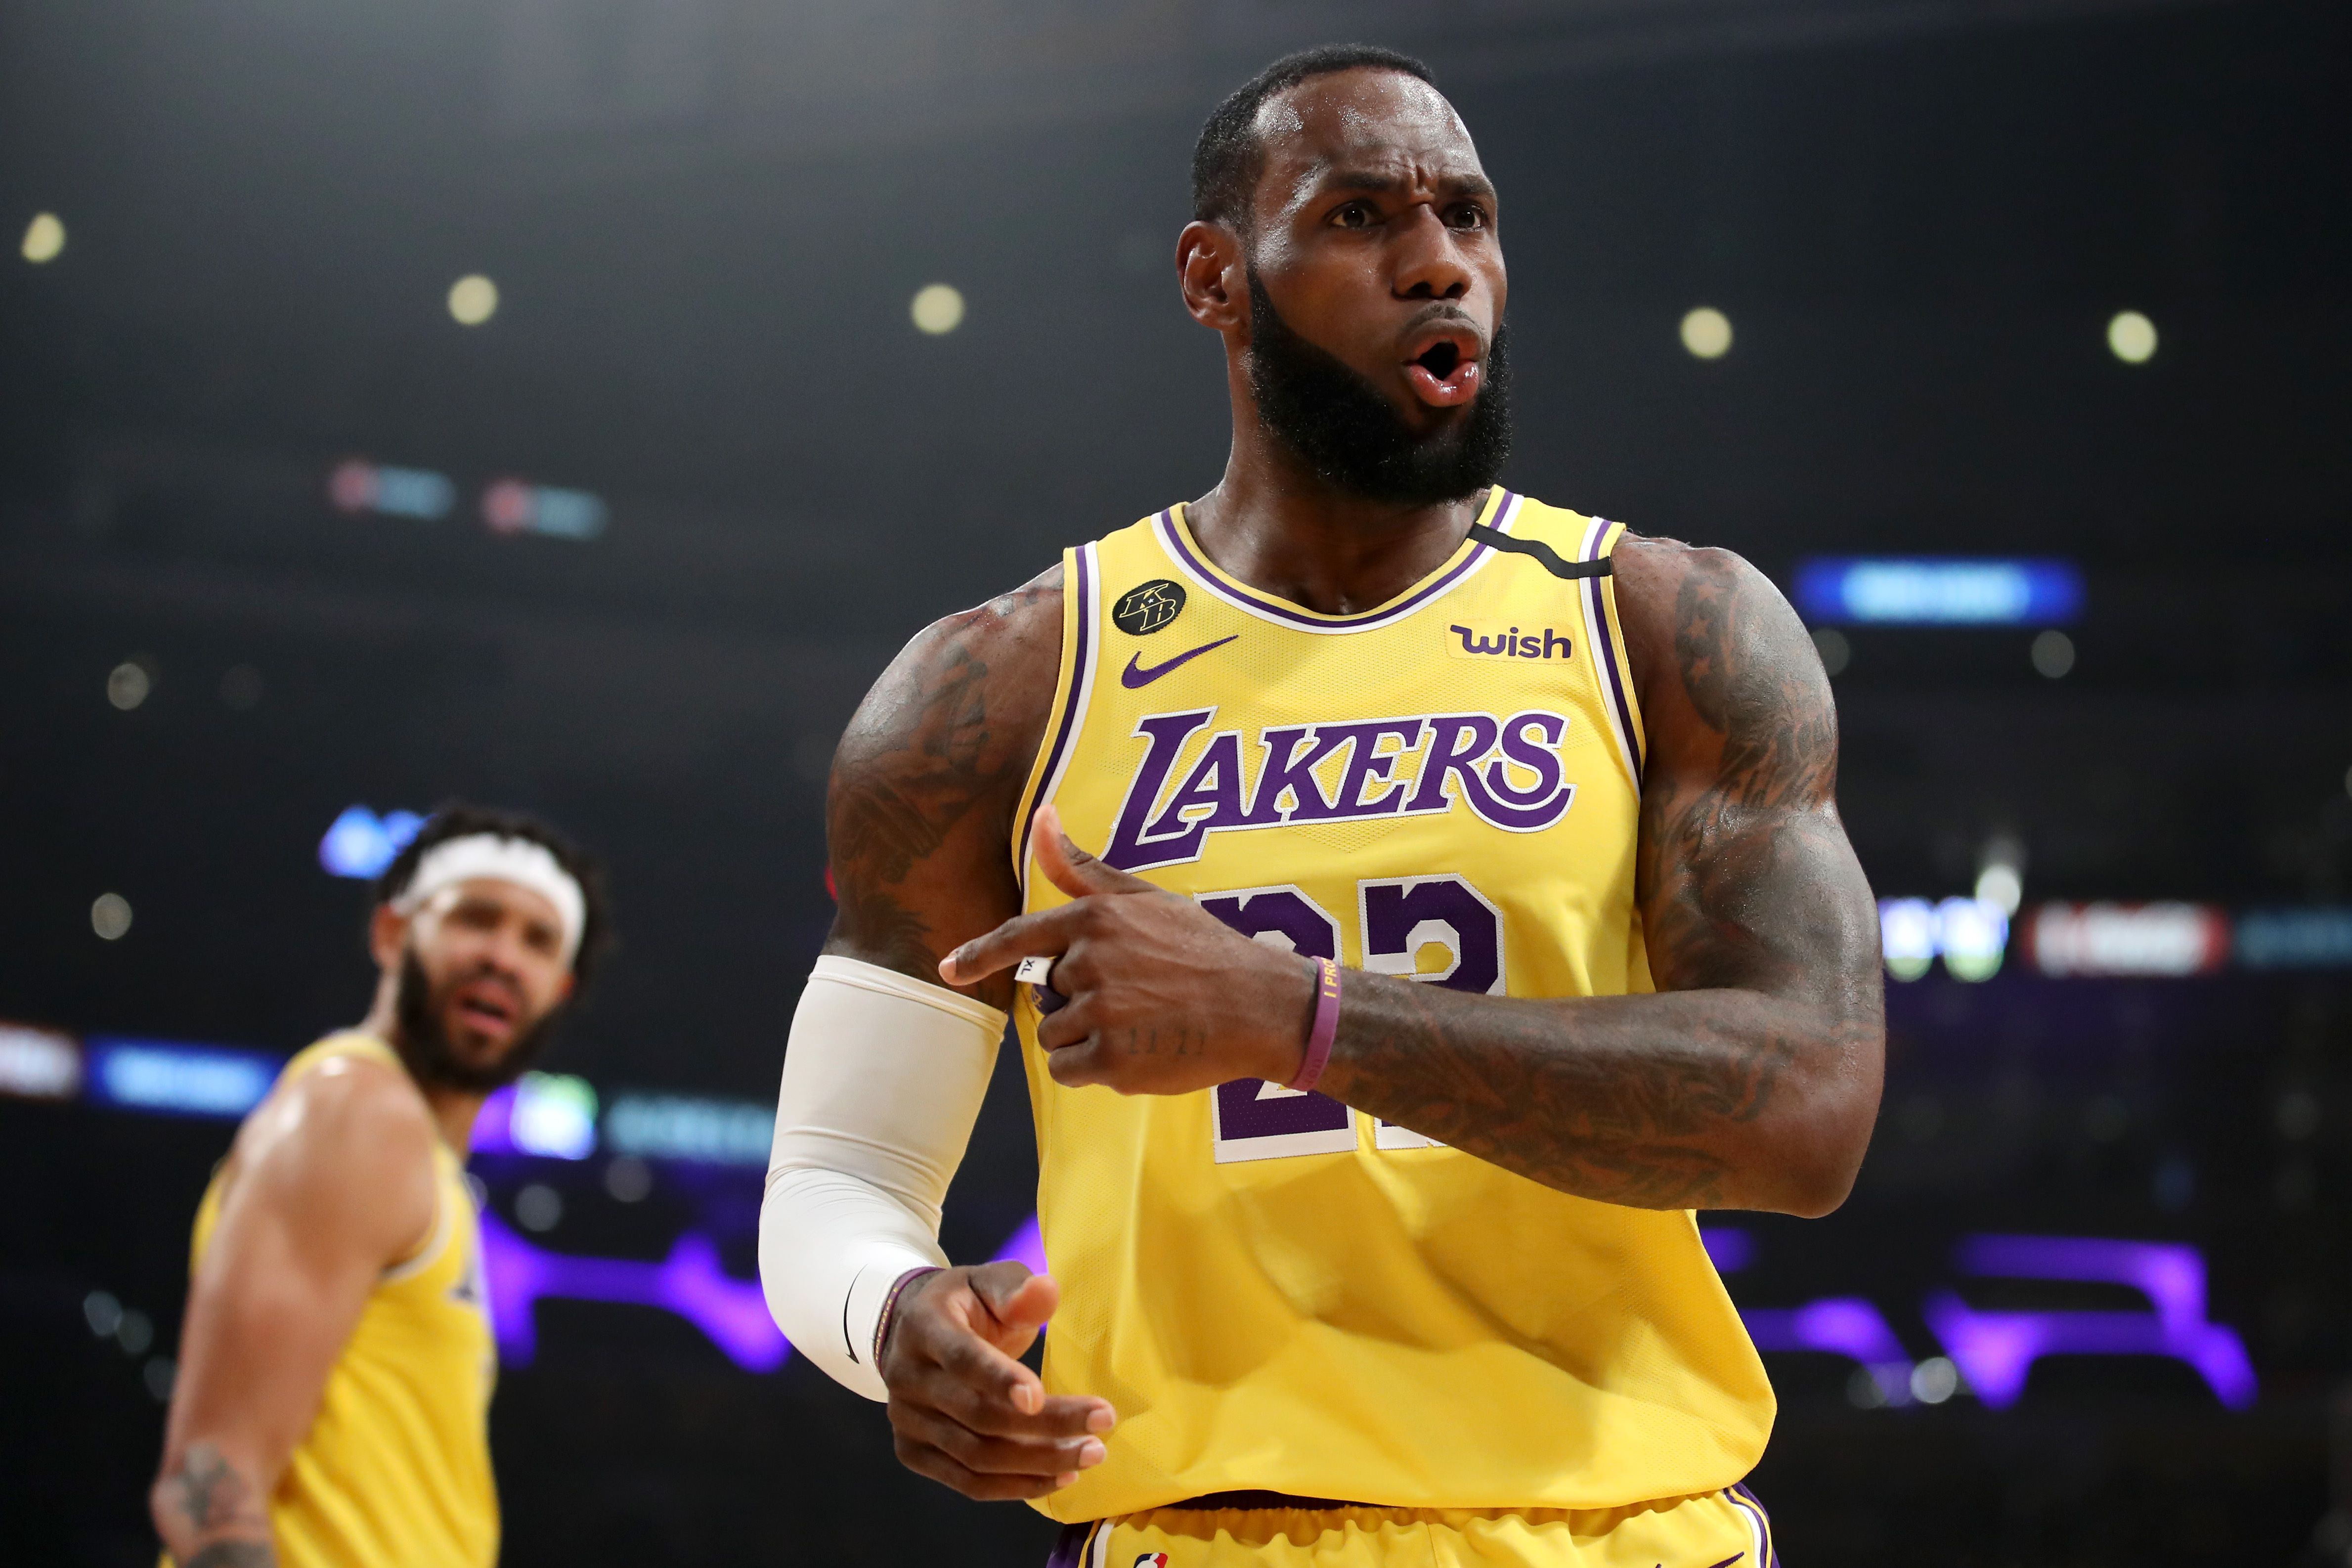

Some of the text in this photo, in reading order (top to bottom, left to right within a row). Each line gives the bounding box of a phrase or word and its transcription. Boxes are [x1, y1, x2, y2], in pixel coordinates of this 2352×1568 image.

[1450, 624, 1571, 659] wish
[1097, 706, 1577, 874] LAKERS
[1020, 959, 1035, 975] XL
[1320, 957, 1338, 988] PRO
